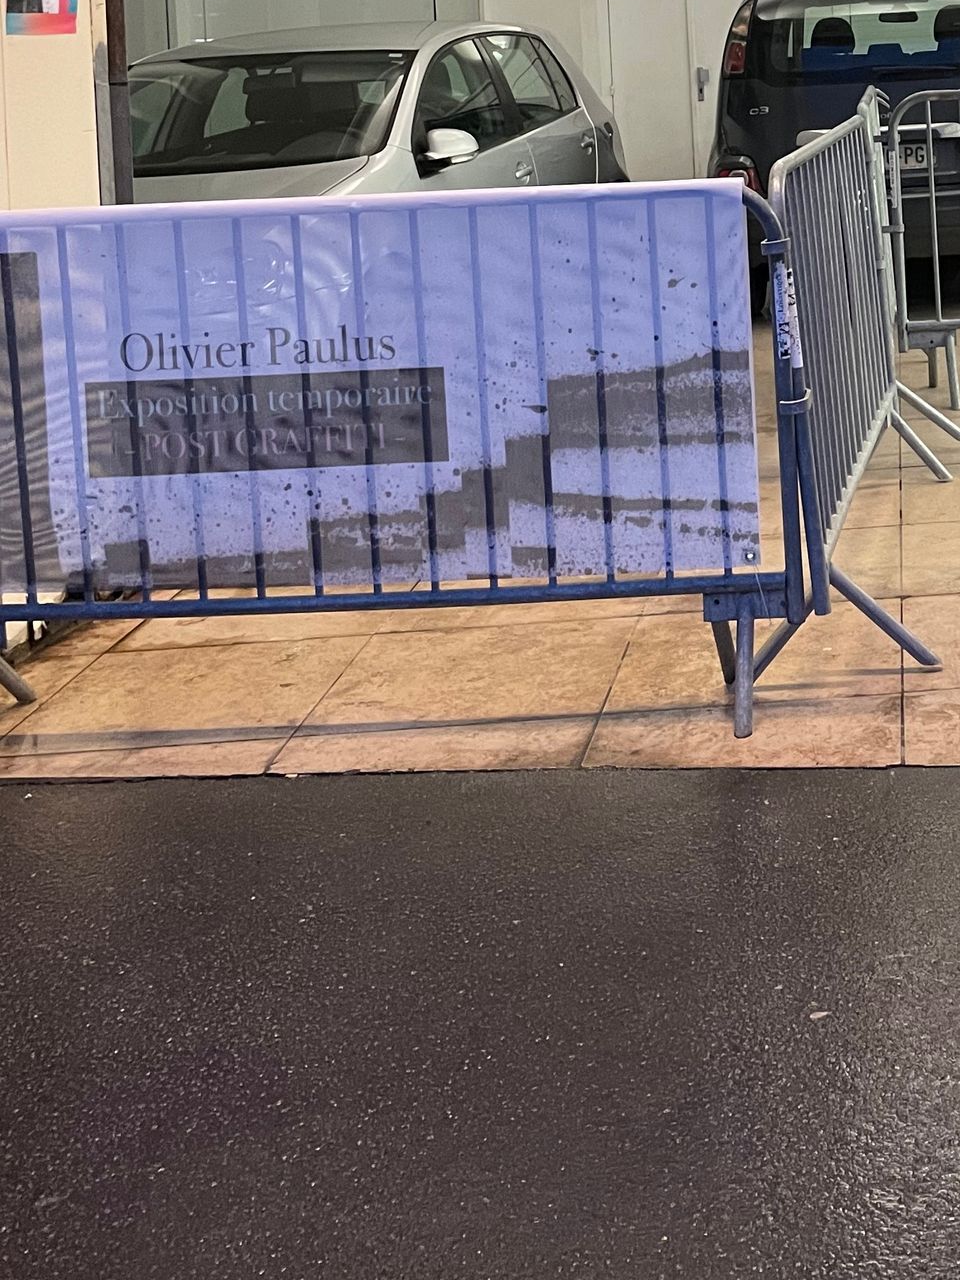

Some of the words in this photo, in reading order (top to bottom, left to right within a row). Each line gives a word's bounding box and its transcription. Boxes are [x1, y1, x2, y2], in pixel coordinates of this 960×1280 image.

[749, 106, 769, 115] C3
[119, 331, 256, 372] Olivier
[265, 324, 396, 366] Paulus
[97, 386, 258, 427] Exposition
[268, 377, 433, 417] temporaire
[143, 430, 227, 461] POST
[234, 422, 386, 456] GRAFFITI
